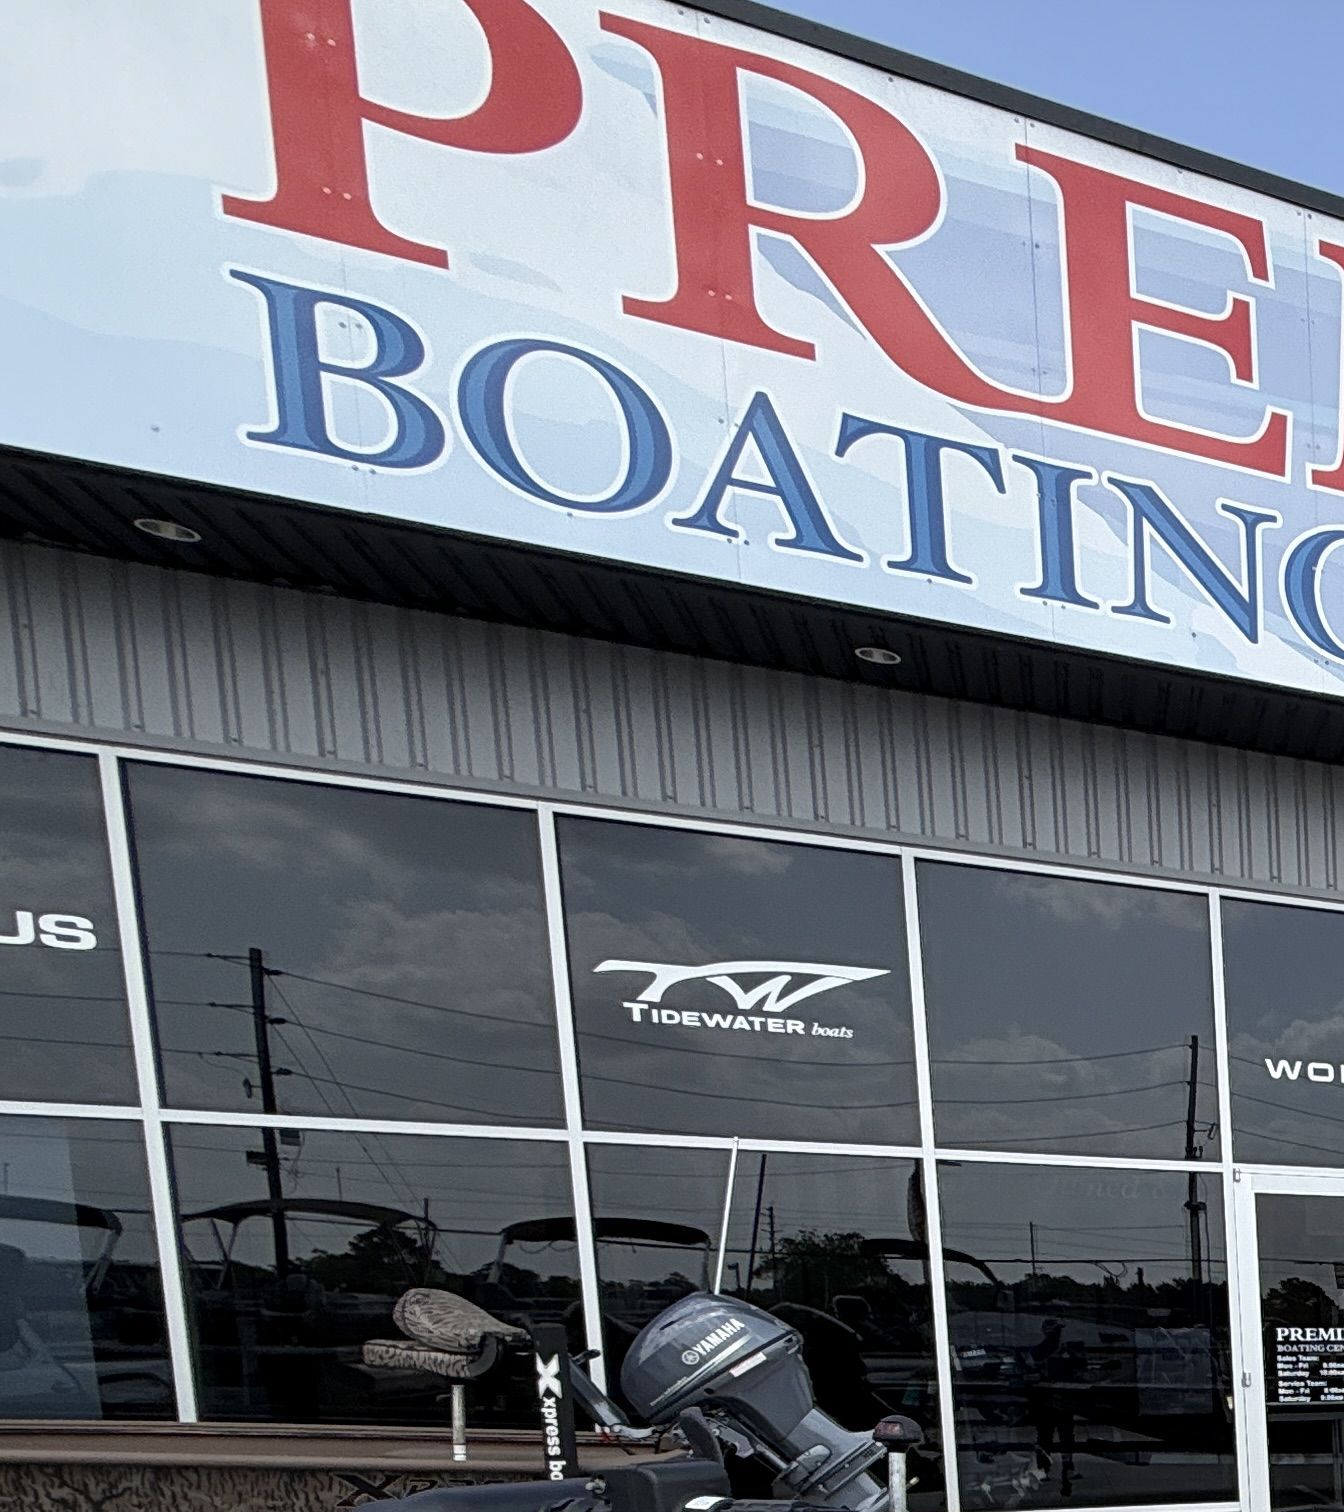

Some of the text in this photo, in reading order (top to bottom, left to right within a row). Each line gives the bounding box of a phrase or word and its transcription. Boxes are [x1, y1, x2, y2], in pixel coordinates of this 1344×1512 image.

[623, 1001, 854, 1039] TIDEWATER boats
[692, 1318, 746, 1356] YAMAHA
[1276, 1344, 1325, 1353] BOATING
[541, 1396, 561, 1456] xpress
